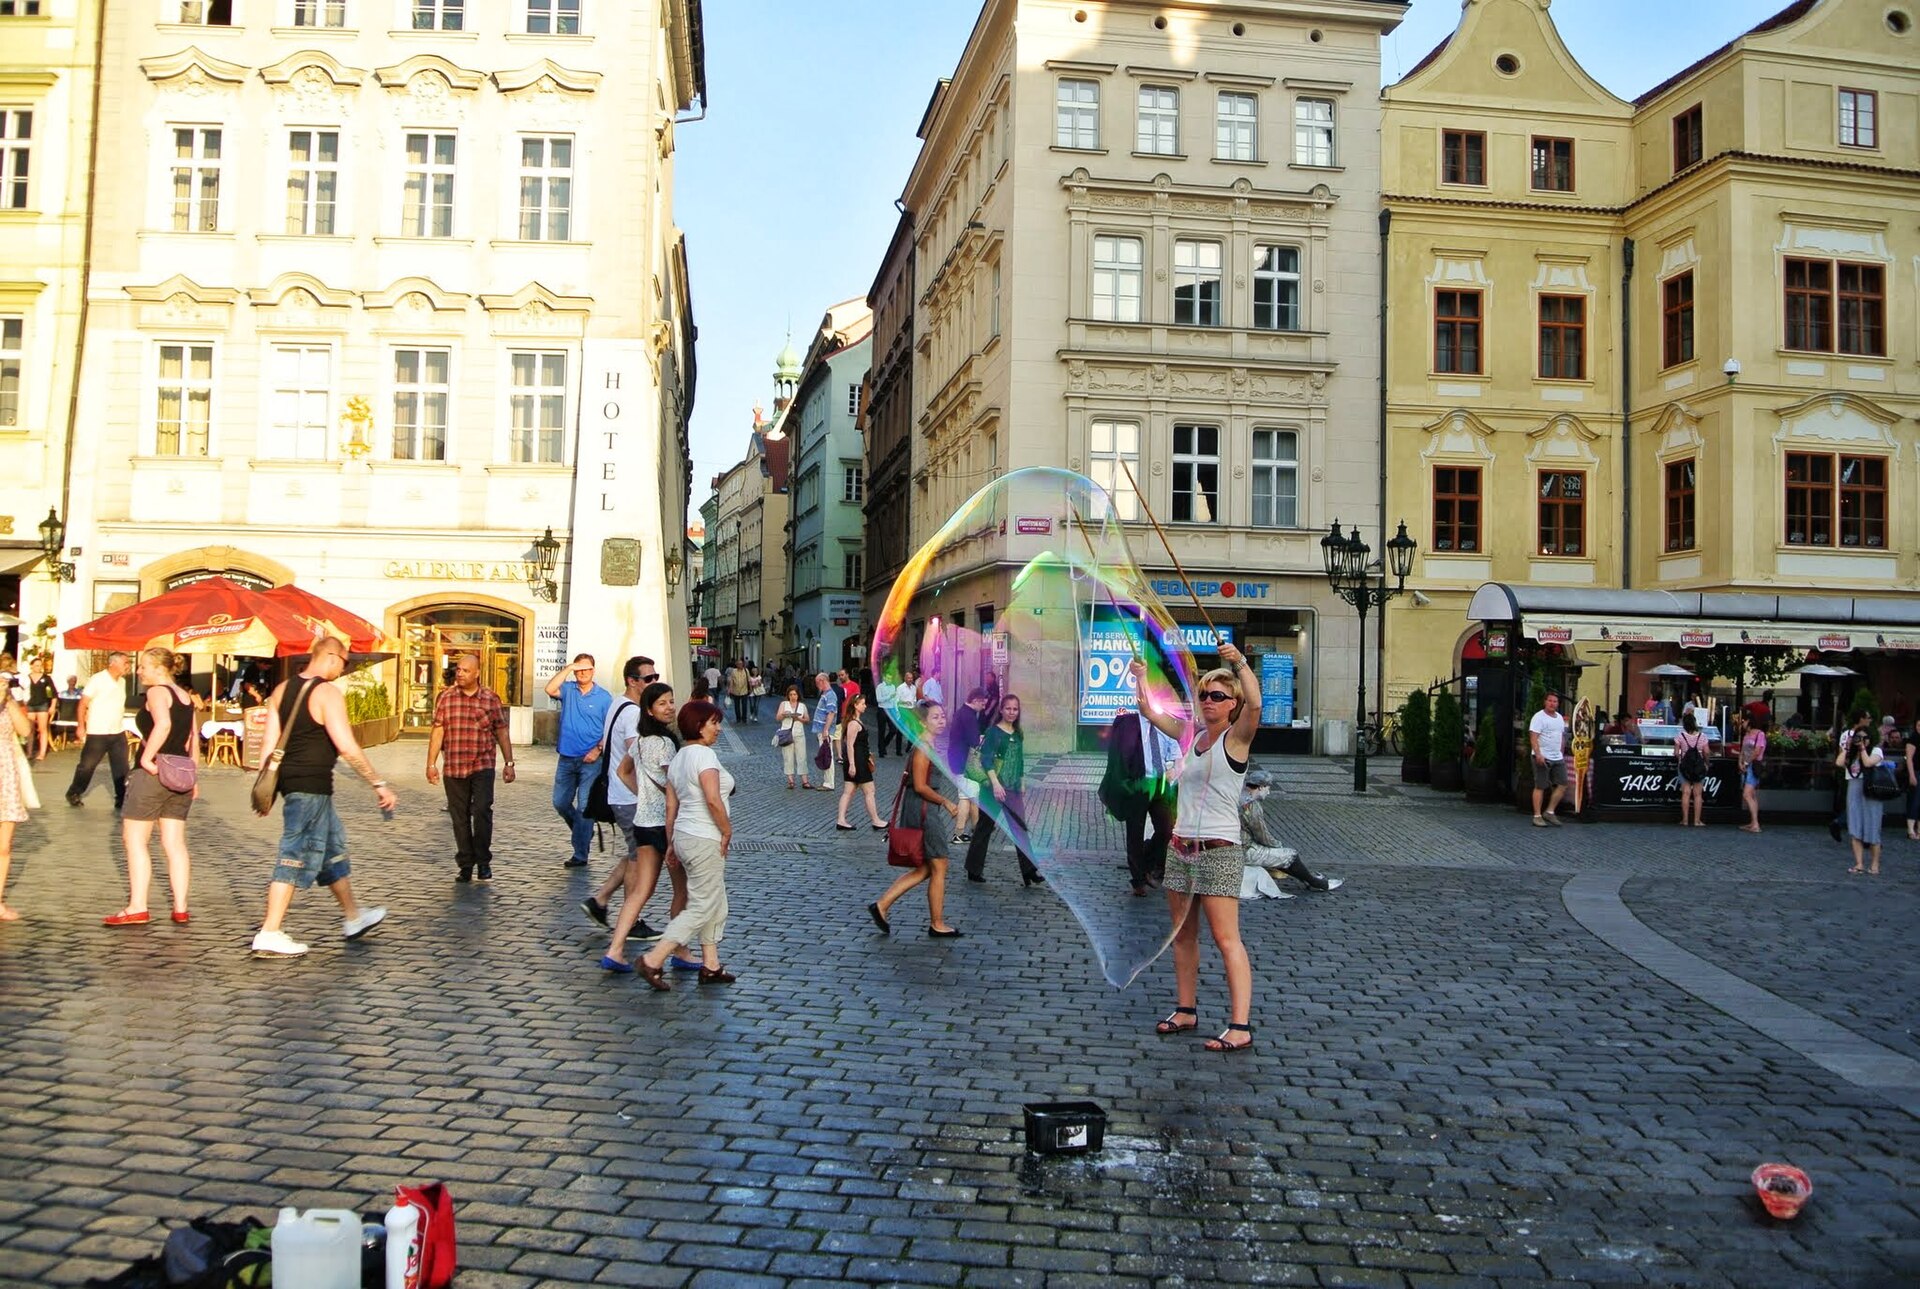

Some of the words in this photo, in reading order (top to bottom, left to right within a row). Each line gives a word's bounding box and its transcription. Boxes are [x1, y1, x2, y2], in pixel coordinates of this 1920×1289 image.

[601, 372, 620, 511] HOTEL
[490, 563, 541, 581] ART
[1619, 774, 1663, 791] TAKE
